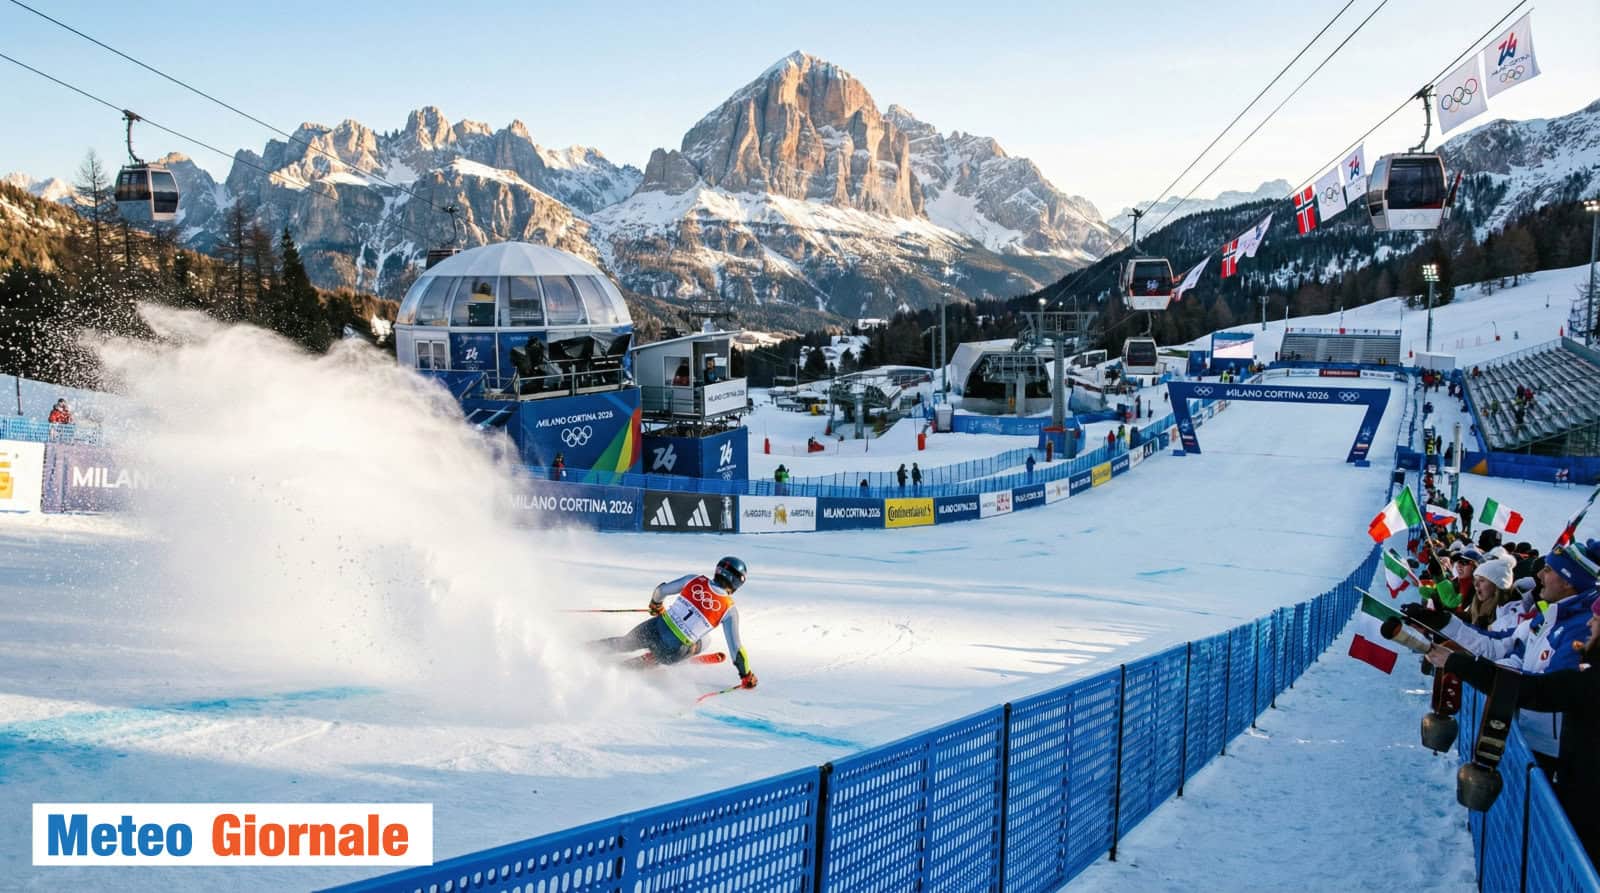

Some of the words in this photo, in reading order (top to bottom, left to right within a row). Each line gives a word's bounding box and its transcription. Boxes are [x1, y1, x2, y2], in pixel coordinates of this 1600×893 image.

[1226, 388, 1262, 399] MILANO
[1264, 389, 1305, 400] CORTINA
[1306, 391, 1329, 401] 2026
[536, 416, 567, 429] MILANO
[567, 413, 597, 425] CORTINA
[512, 495, 557, 511] MILANO
[559, 496, 608, 513] CORTINA
[609, 499, 634, 515] 2026
[823, 507, 845, 518] MILANO
[683, 609, 694, 621] 1
